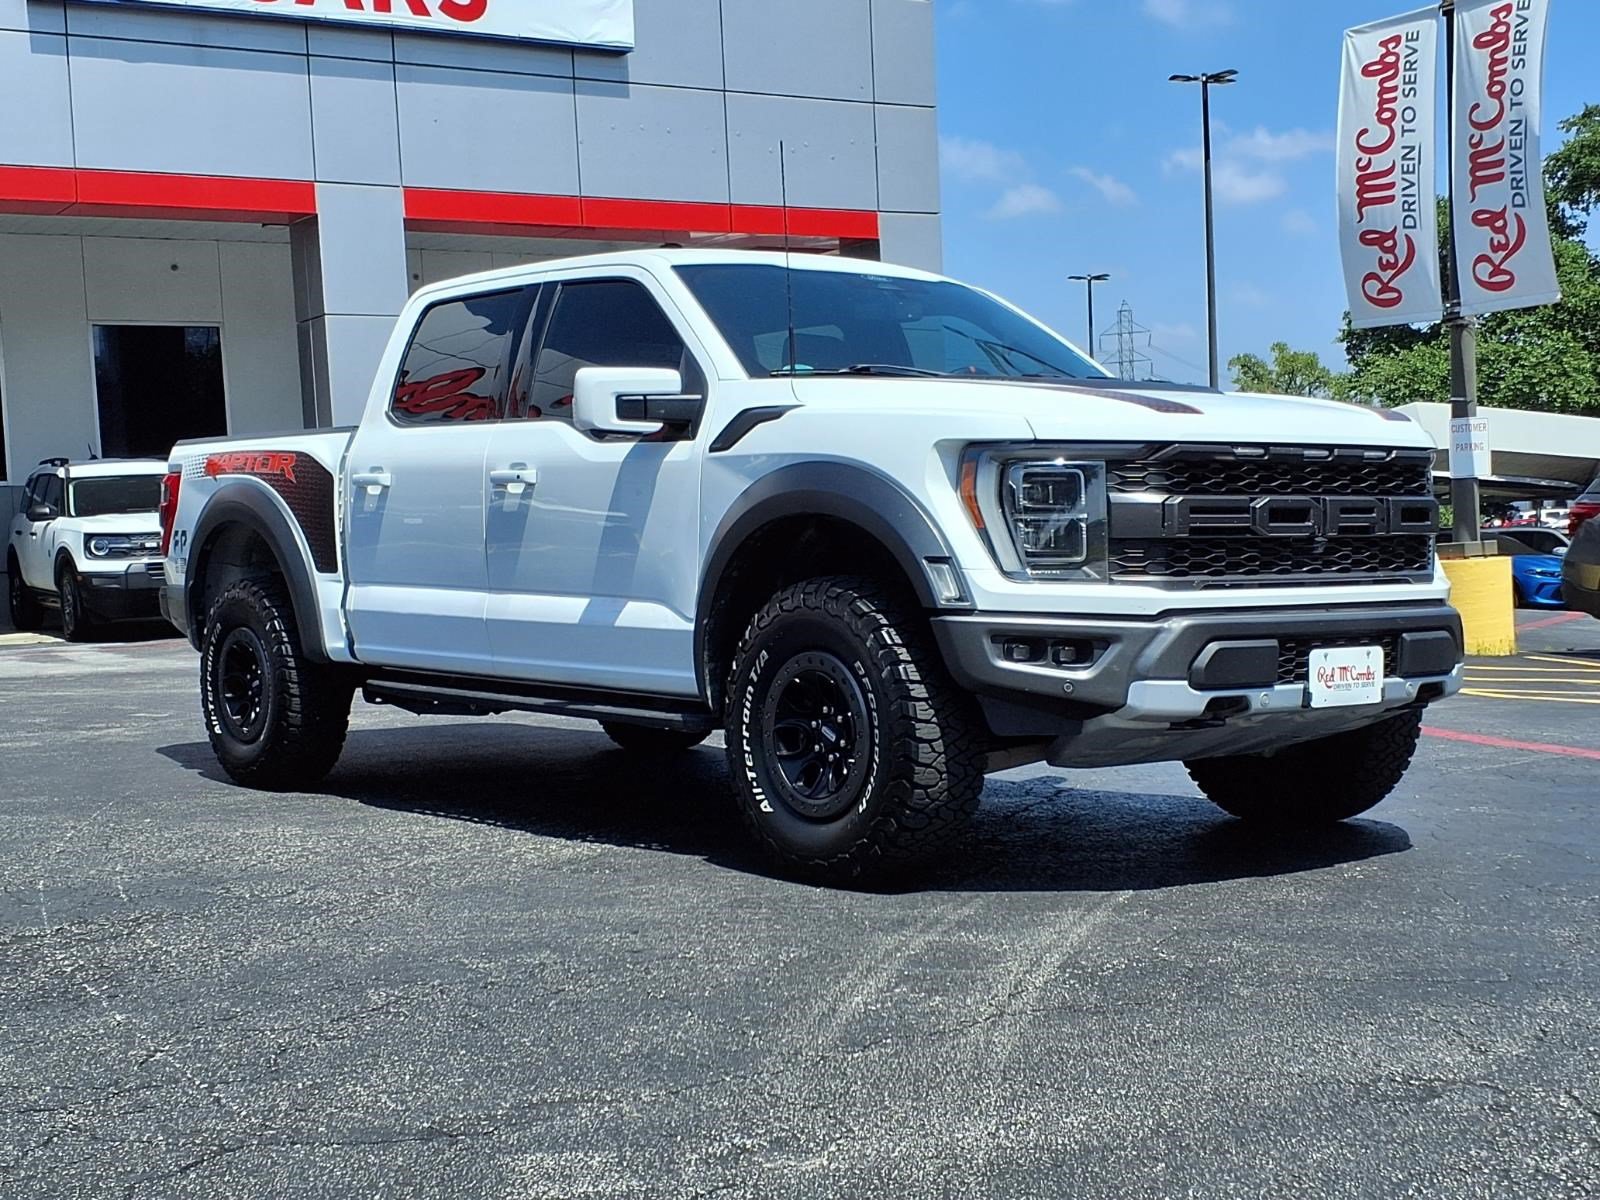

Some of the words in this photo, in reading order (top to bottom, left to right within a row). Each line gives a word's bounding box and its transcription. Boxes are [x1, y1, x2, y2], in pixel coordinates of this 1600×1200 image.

[1402, 30, 1420, 98] SERVE
[1511, 0, 1531, 70] SERVE
[1355, 33, 1402, 224] McCombs
[1401, 105, 1417, 138] TO
[1468, 2, 1513, 203] McCombs
[1509, 79, 1525, 111] TO
[1401, 145, 1418, 230] DRIVEN
[1508, 120, 1526, 209] DRIVEN
[1359, 225, 1416, 309] Red
[1471, 203, 1527, 292] Red
[1450, 422, 1487, 433] CUSTOMER
[1455, 442, 1485, 452] PARKING
[1163, 495, 1440, 537] FORD
[749, 649, 769, 683] T/A
[1317, 666, 1335, 689] Red
